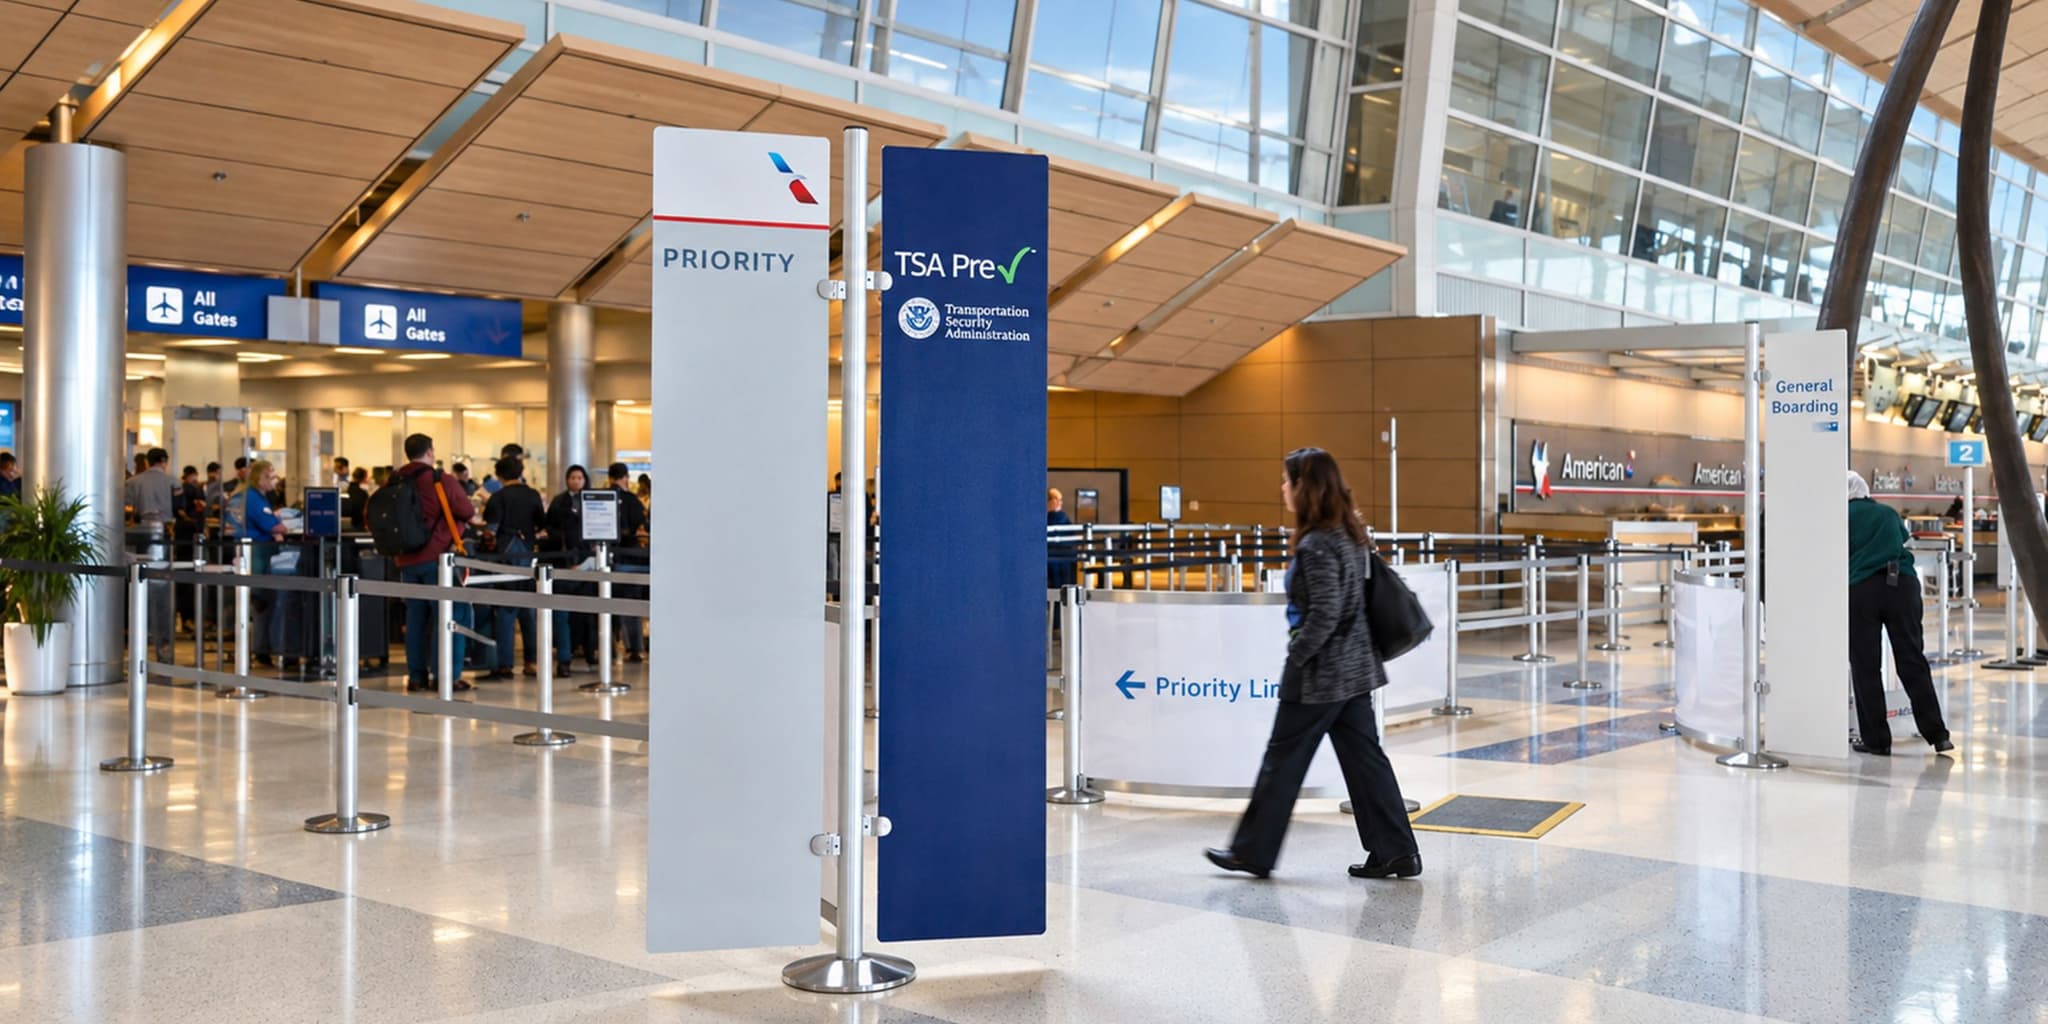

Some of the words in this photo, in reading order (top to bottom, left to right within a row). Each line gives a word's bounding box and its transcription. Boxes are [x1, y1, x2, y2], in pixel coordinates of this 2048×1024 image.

[663, 247, 795, 273] PRIORITY
[894, 251, 946, 277] TSA
[952, 253, 996, 279] Pre
[193, 290, 216, 307] All
[193, 311, 238, 327] Gates
[406, 307, 427, 323] All
[944, 303, 1030, 318] Transportation
[945, 316, 993, 331] Security
[405, 326, 446, 342] Gates
[944, 328, 1031, 342] Administration
[1775, 378, 1833, 394] General
[1771, 399, 1839, 416] Boarding
[1959, 444, 1974, 461] 2
[1561, 452, 1625, 481] American
[1693, 461, 1742, 486] American
[1156, 676, 1242, 703] Priority
[1249, 678, 1281, 699] Lin
